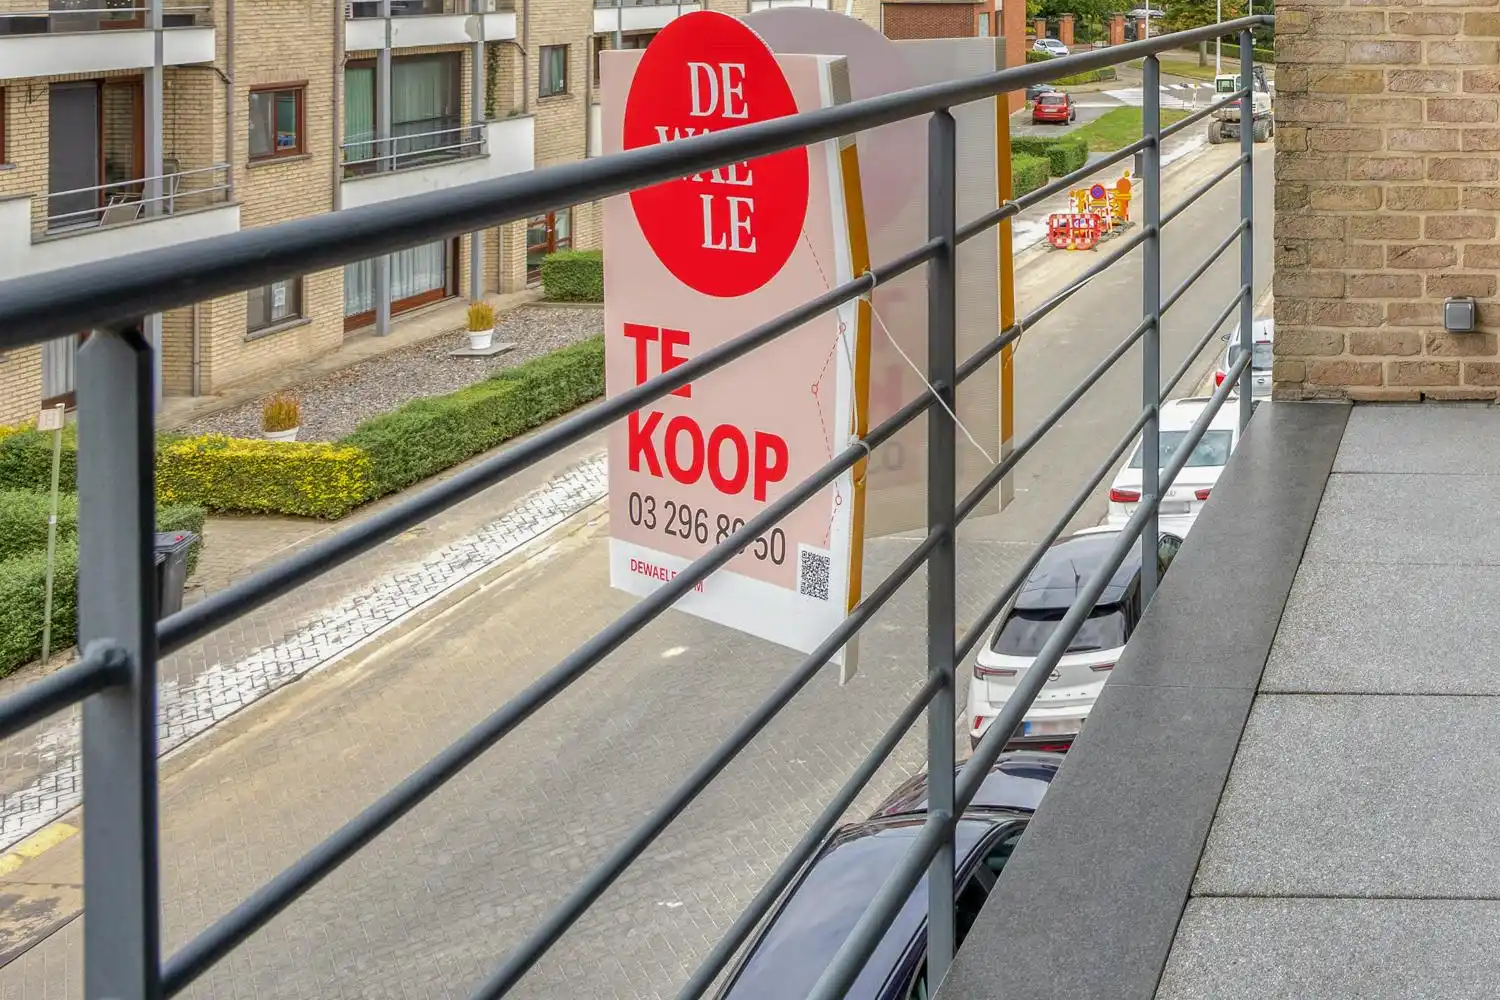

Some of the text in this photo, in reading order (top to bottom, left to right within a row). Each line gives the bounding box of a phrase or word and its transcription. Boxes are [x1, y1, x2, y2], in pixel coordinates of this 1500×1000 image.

[687, 62, 749, 119] DE
[700, 193, 757, 253] LE
[623, 322, 692, 399] TE
[627, 408, 789, 502] KOOP
[629, 491, 657, 530] 03
[664, 500, 709, 544] 296
[753, 526, 786, 565] 50
